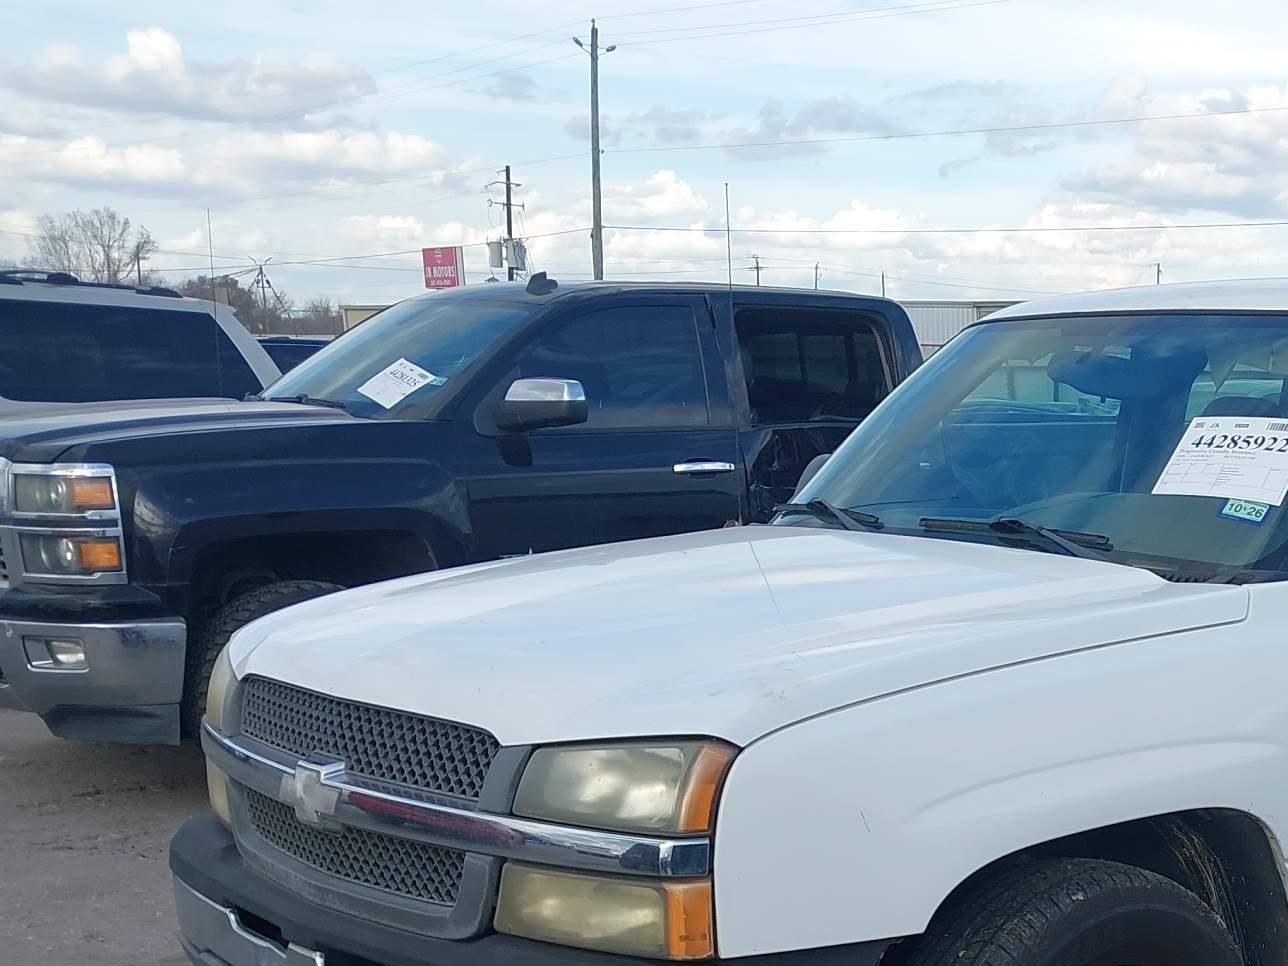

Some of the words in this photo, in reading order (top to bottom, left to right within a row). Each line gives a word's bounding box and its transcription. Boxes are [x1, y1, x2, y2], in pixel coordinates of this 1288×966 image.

[432, 265, 455, 278] MOTORS
[1228, 503, 1243, 514] 10
[1246, 507, 1264, 518] 26
